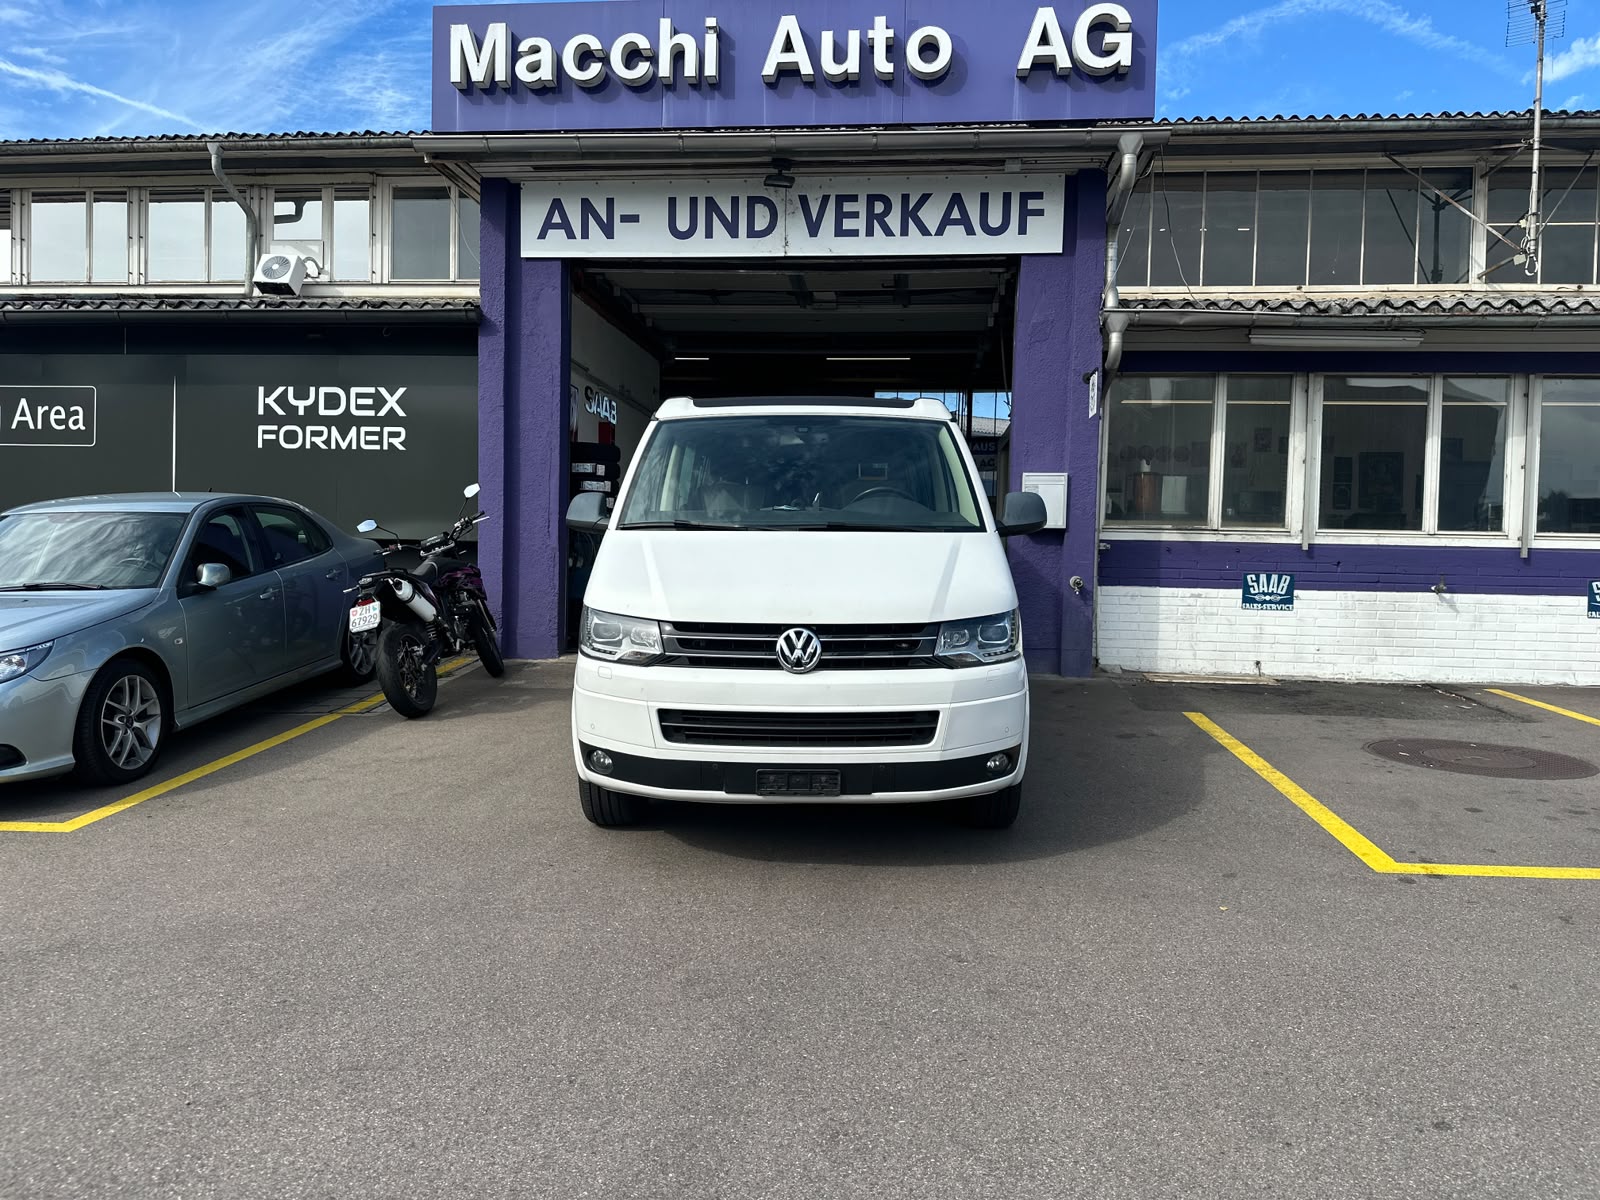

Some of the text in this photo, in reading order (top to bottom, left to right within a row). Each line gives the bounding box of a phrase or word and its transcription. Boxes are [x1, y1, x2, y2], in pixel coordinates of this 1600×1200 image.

[450, 3, 1132, 88] Macchi Auto AG
[537, 191, 1045, 241] AN- UND VERKAUF
[11, 397, 86, 430] Area
[257, 386, 408, 417] KYDEX
[584, 386, 618, 425] SAAB
[257, 424, 407, 450] FORMER
[1246, 573, 1291, 595] SAAB
[352, 613, 377, 627] 67929
[359, 606, 370, 616] ZH
